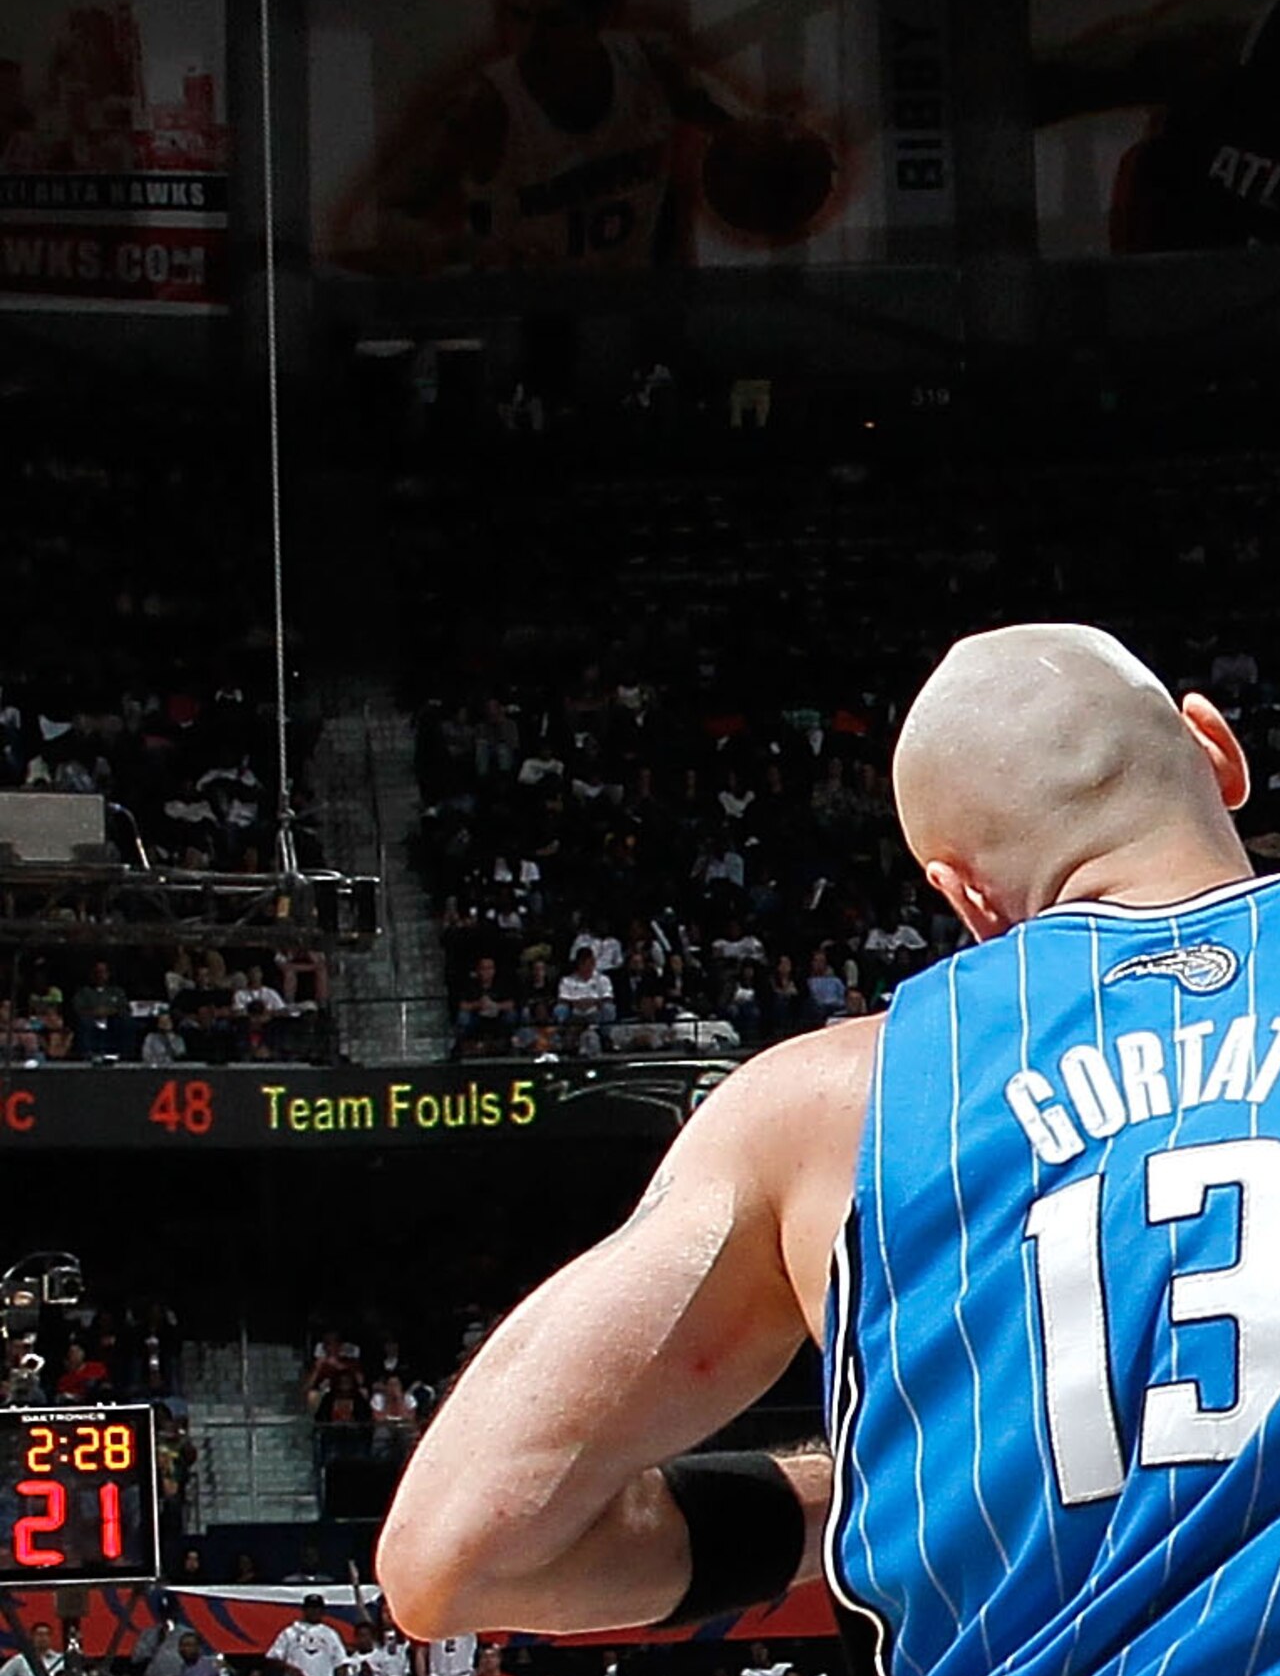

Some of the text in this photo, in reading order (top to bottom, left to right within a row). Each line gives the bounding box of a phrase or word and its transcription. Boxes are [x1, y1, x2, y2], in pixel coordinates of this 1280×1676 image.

[891, 16, 945, 192] BIBBY
[110, 181, 207, 207] HAWKS
[149, 1081, 213, 1133] 48
[262, 1085, 373, 1129] Team
[388, 1082, 500, 1128] Fouls
[510, 1081, 535, 1125] 5
[27, 1426, 131, 1472] 2:28
[14, 1480, 122, 1566] 21
